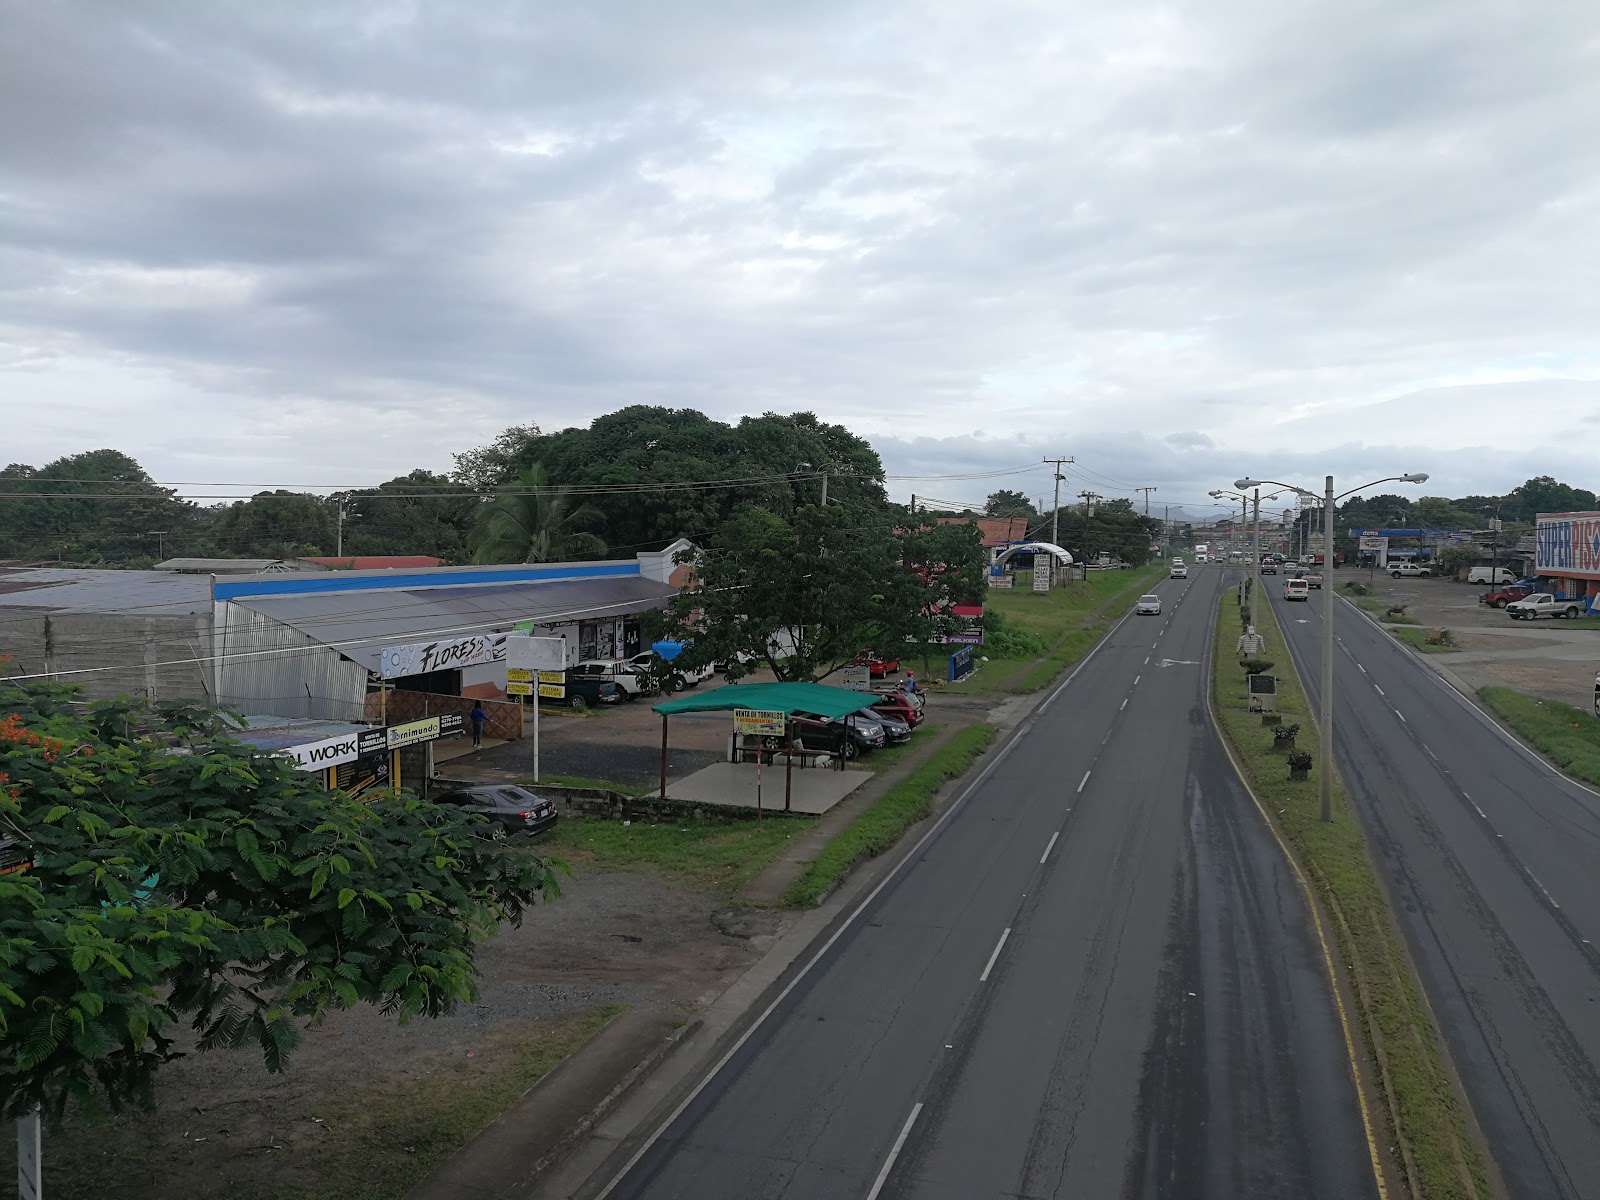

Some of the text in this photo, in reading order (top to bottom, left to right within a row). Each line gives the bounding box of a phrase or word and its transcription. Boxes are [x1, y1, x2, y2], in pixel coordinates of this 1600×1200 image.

[758, 711, 783, 719] TORNILLOS
[360, 736, 386, 748] TORNILLOS
[309, 740, 356, 762] WORK
